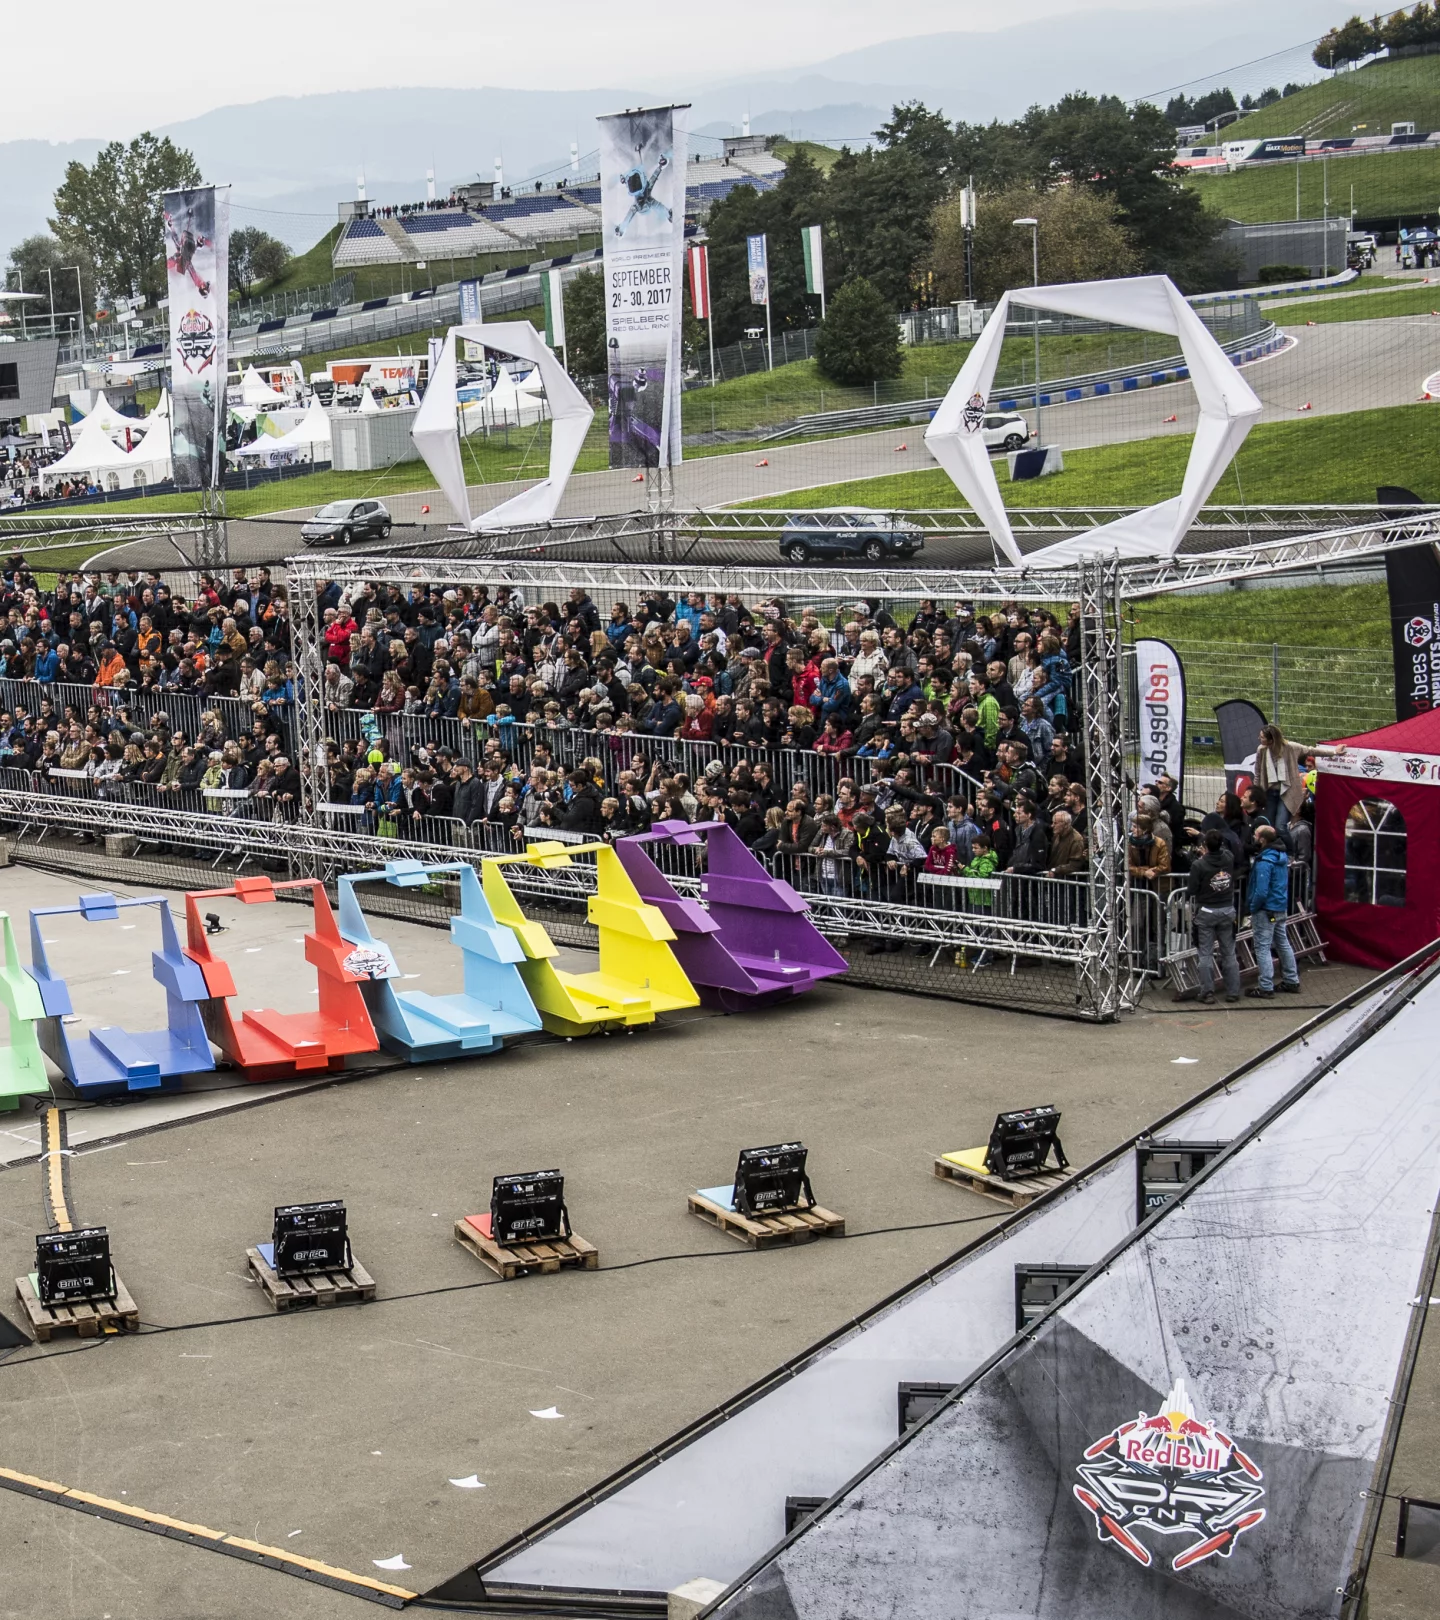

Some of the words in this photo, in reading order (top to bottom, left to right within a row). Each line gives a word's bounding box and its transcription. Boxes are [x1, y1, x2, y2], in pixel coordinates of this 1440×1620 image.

[612, 267, 671, 288] SEPTEMBER
[612, 293, 621, 308] 29
[630, 290, 645, 306] 30,
[647, 288, 671, 305] 2017
[1126, 1439, 1172, 1465] Red
[1175, 1443, 1220, 1470] Bull
[1132, 1505, 1202, 1522] ONE
